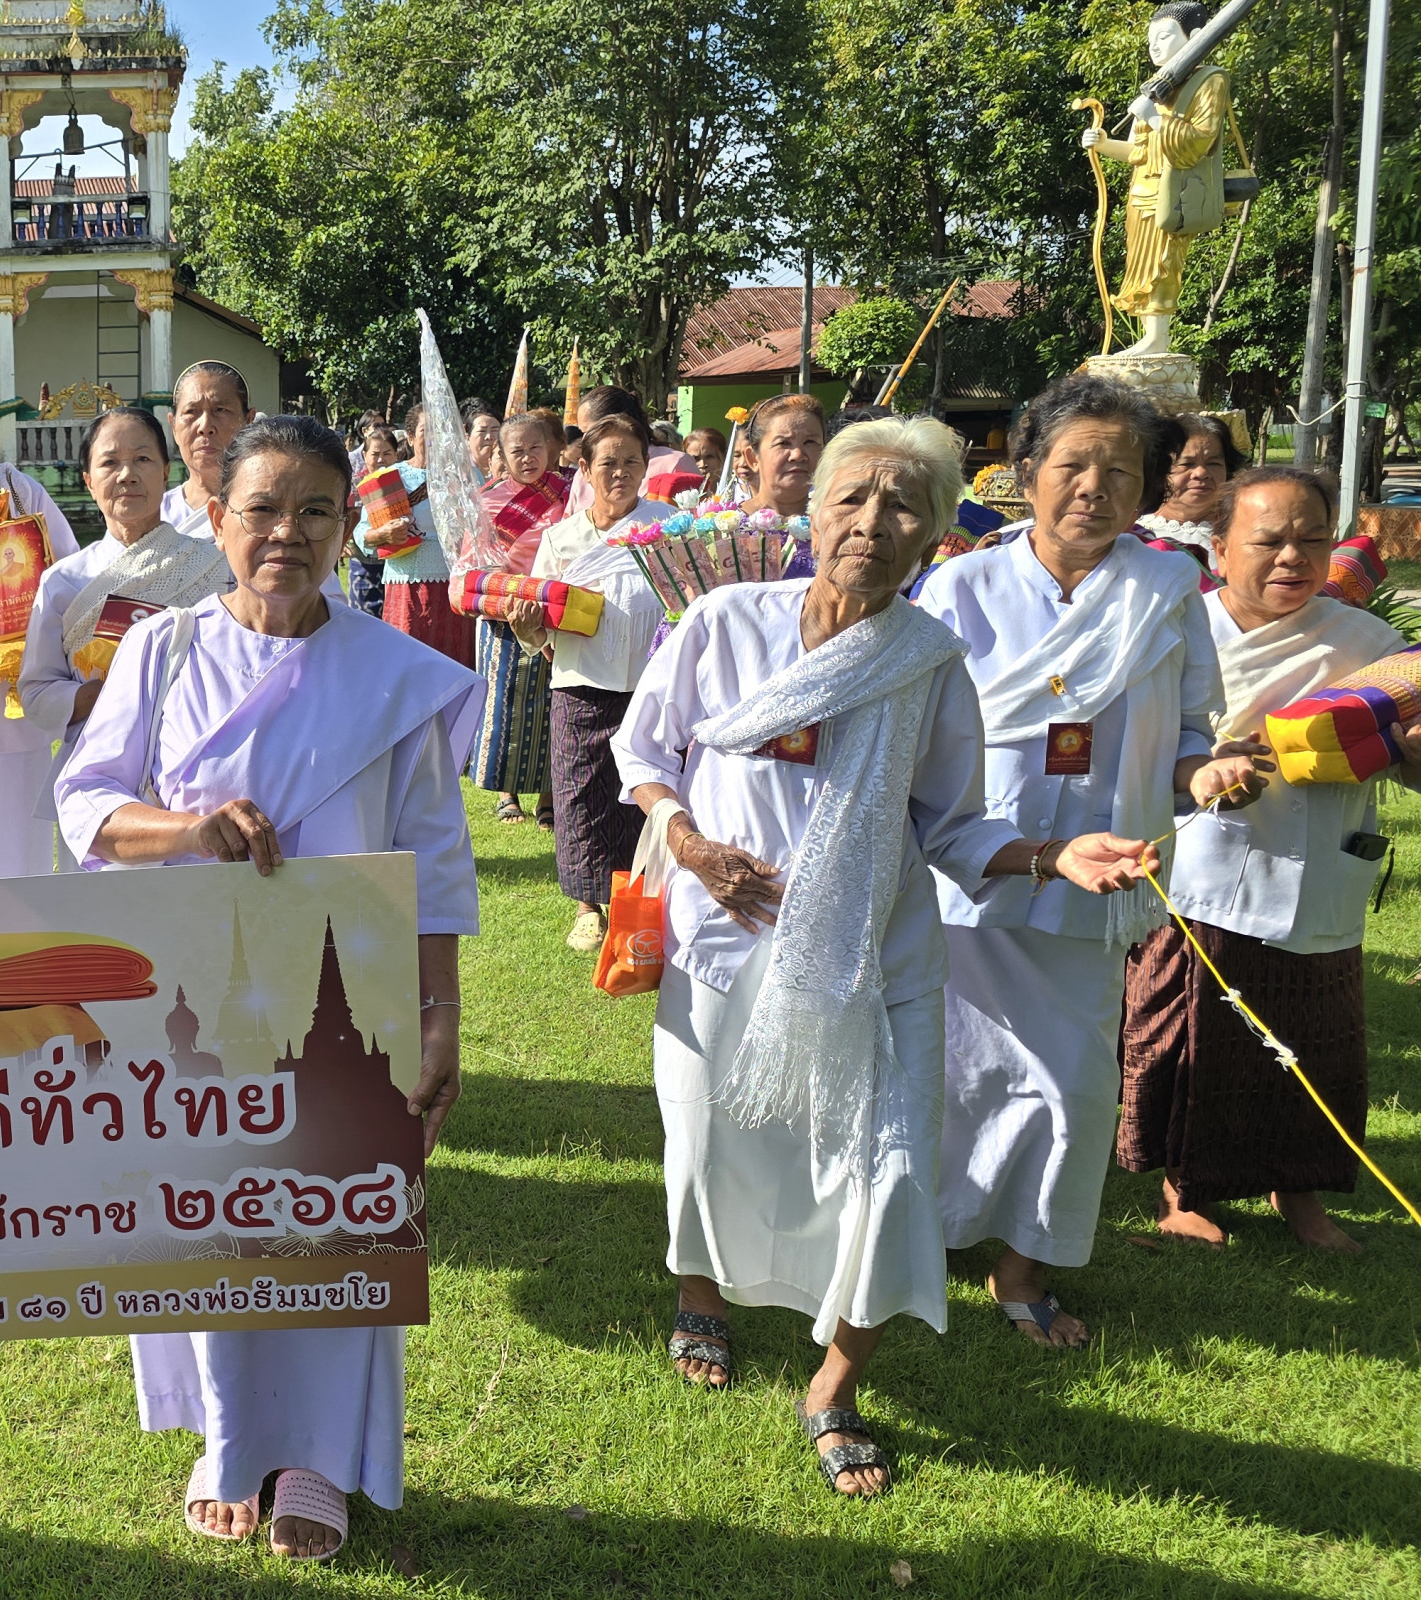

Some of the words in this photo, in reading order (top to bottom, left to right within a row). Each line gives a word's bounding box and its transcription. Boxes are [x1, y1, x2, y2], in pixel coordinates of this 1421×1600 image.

[158, 1172, 398, 1232] ๒๕๖๘
[19, 1297, 68, 1320] ๘๑
[80, 1284, 104, 1316] ปี
[116, 1274, 387, 1315] หลวงพ่อธัมมชโย
